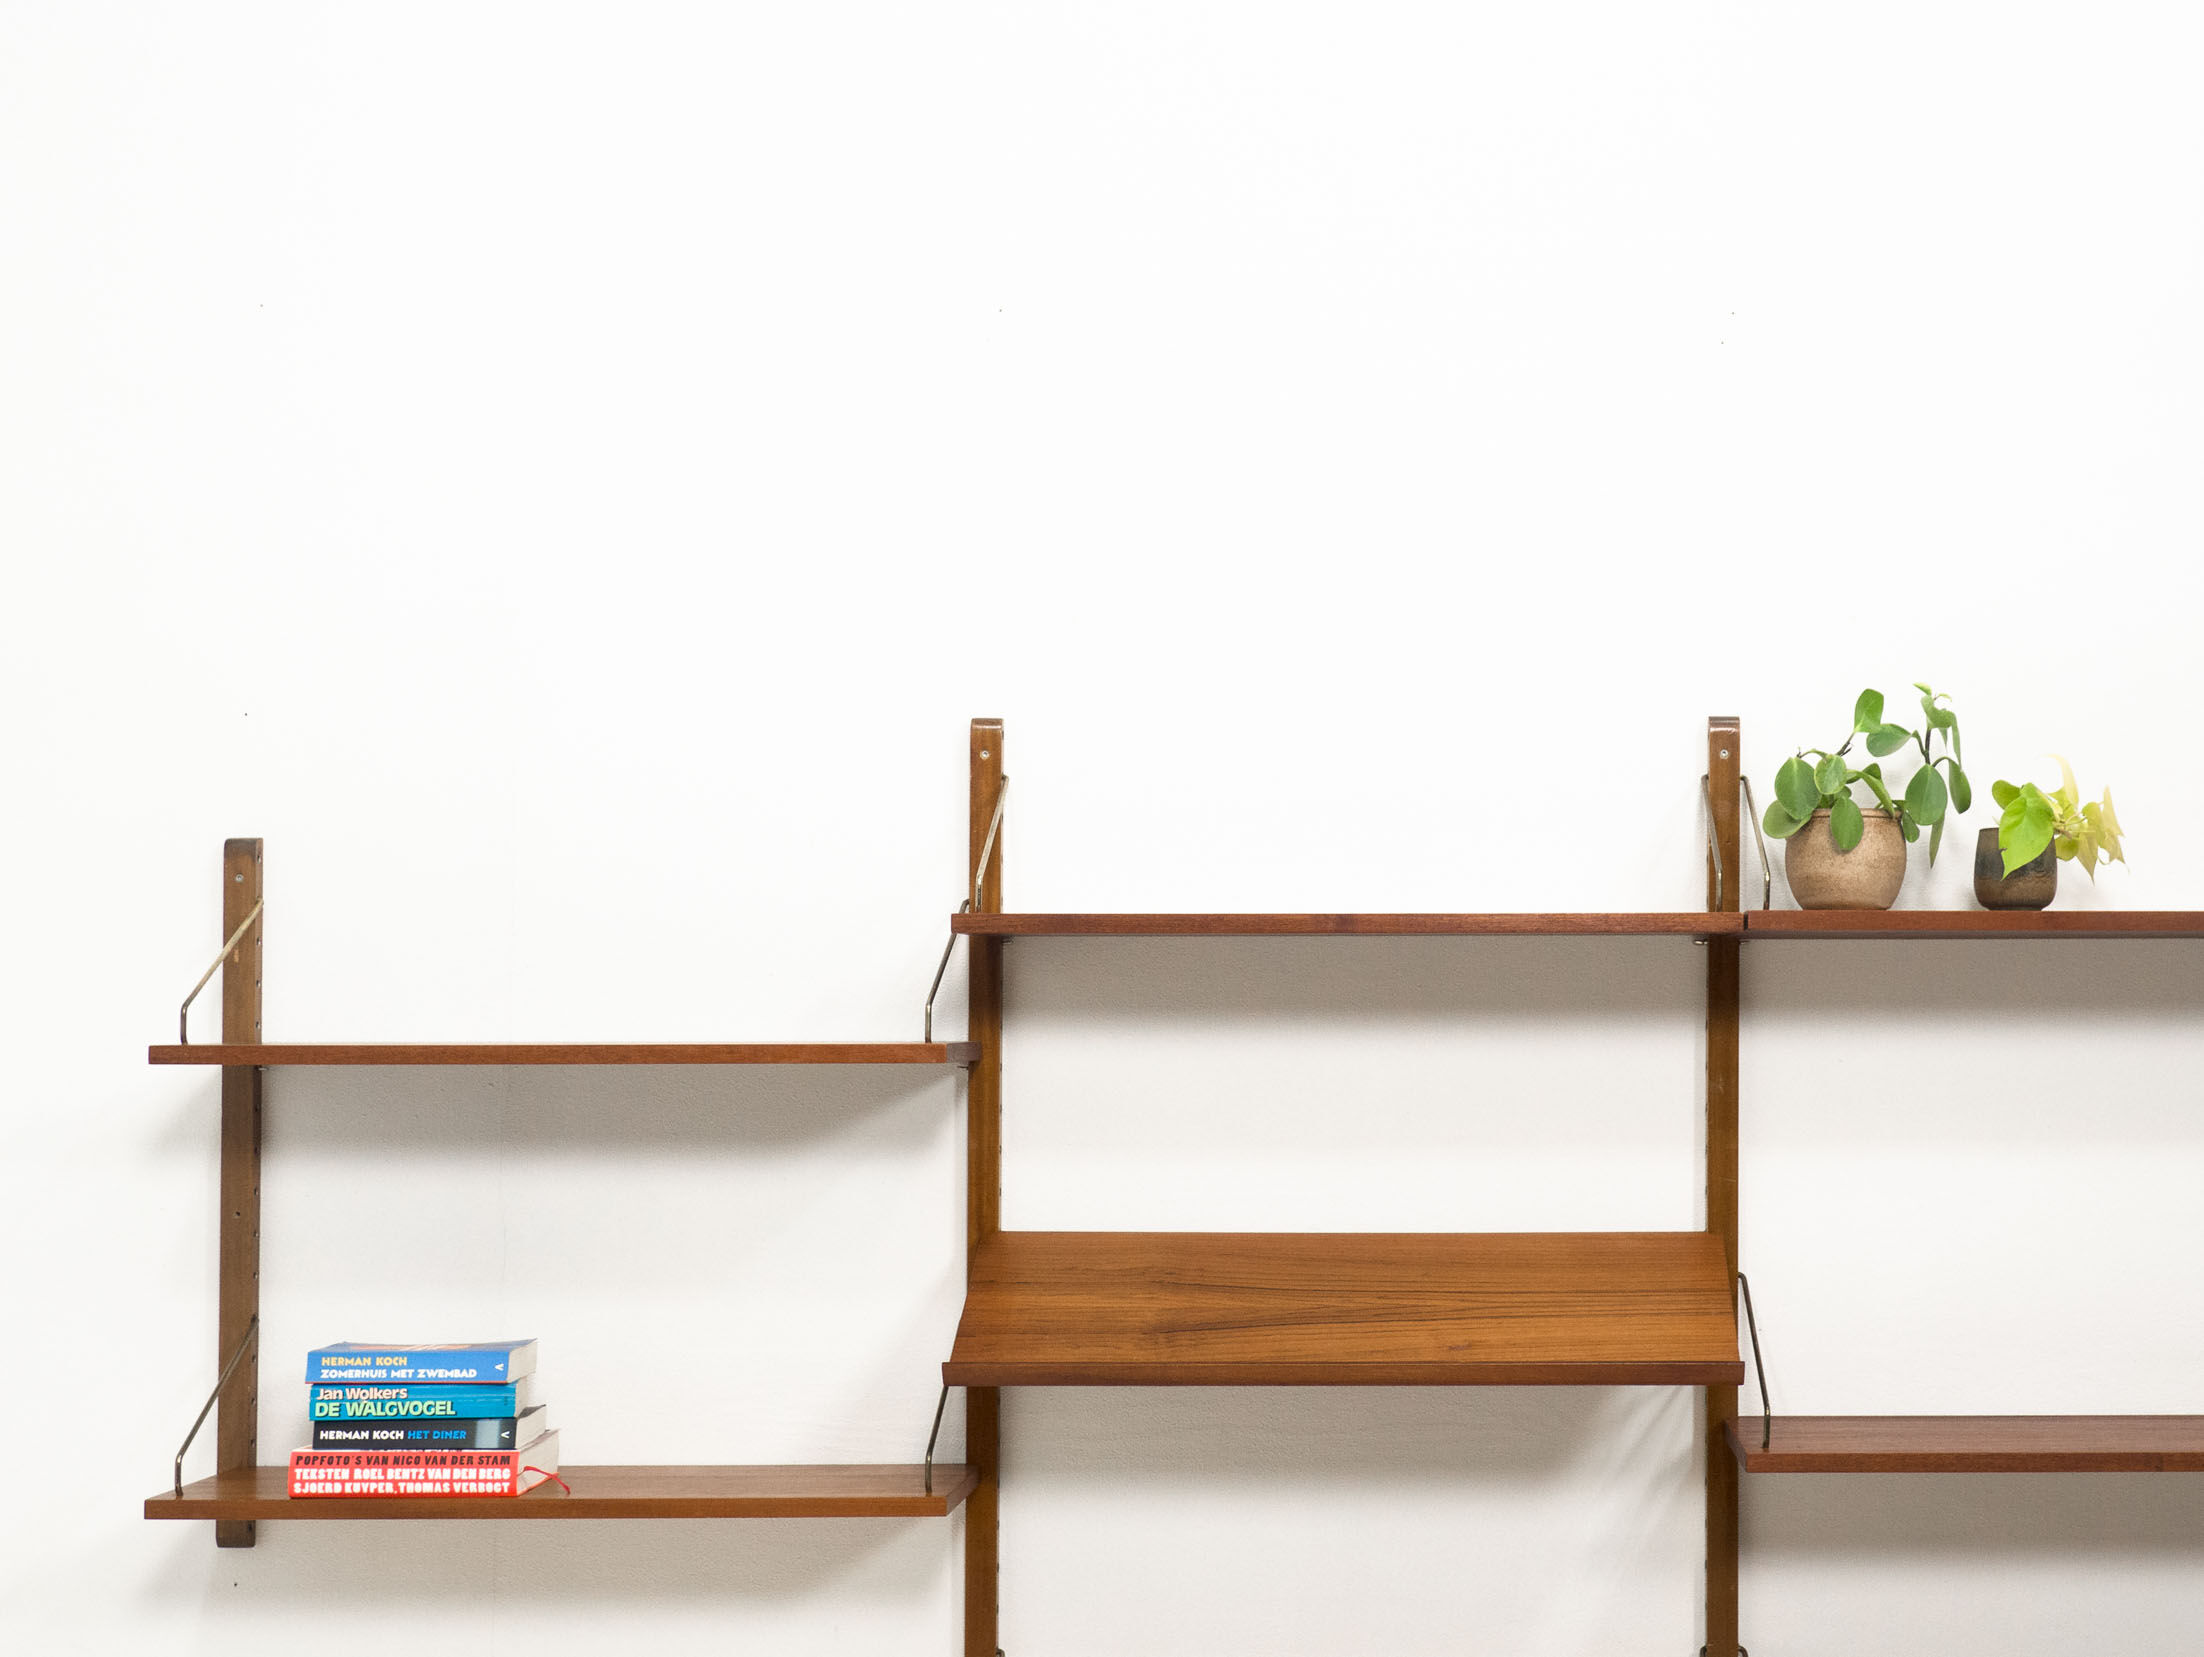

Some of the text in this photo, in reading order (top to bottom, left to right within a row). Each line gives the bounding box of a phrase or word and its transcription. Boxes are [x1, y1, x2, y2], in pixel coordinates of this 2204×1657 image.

[321, 1357, 407, 1366] HERMAN KOCH
[320, 1369, 477, 1378] ZOMERHUIS MET ZWEMBAD
[316, 1388, 408, 1401] Jan Wolkers
[315, 1401, 456, 1417] DE WALGVOGEL
[319, 1430, 466, 1440] HERMAN KOCH HET DINER
[367, 1456, 388, 1465] VAN
[392, 1456, 421, 1465] NICO
[424, 1456, 447, 1465] VAN
[451, 1456, 474, 1465] DER
[477, 1456, 511, 1465] STAM
[295, 1468, 511, 1480] TEKSTEN ROEL BENTZ VAN DEN BERG
[294, 1482, 342, 1493] SJOERD
[398, 1482, 450, 1493] THOMAS
